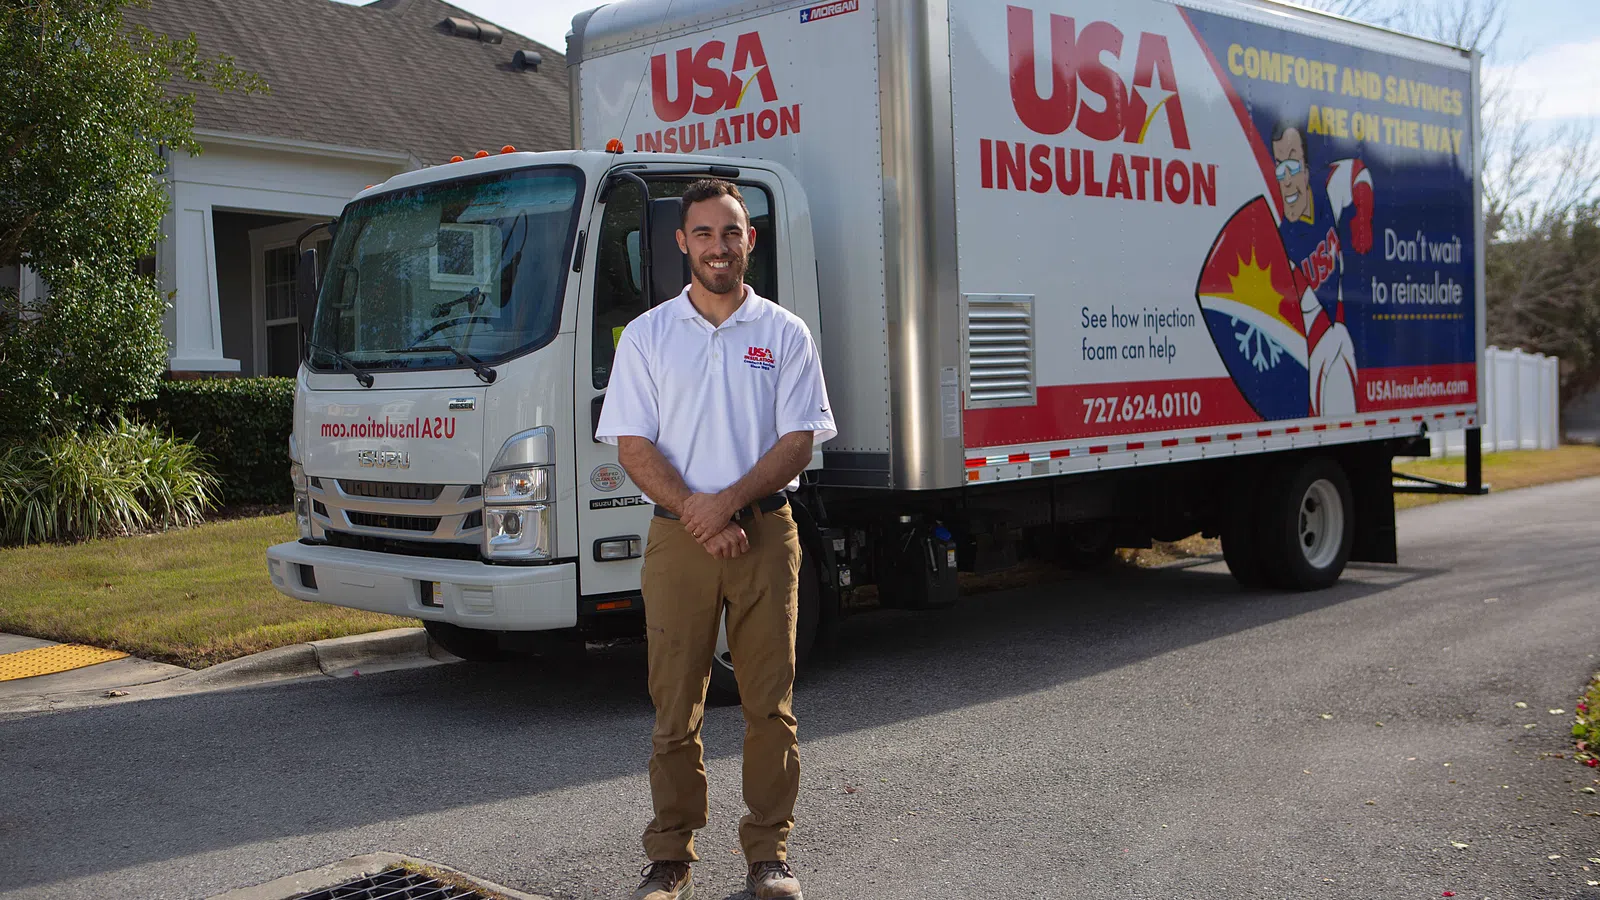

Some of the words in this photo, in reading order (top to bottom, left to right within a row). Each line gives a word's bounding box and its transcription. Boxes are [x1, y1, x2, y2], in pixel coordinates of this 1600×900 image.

[810, 0, 857, 20] MORGAN
[651, 31, 778, 122] USA
[1007, 5, 1191, 150] USA
[1228, 43, 1338, 93] COMFORT
[1341, 67, 1382, 101] AND
[1385, 74, 1464, 117] SAVINGS
[636, 104, 801, 154] INSULATION
[1307, 104, 1349, 139] ARE
[1352, 111, 1380, 144] ON
[1382, 116, 1421, 149] THE
[1421, 124, 1463, 155] WAY
[980, 138, 1217, 207] INSULATION
[1301, 226, 1341, 292] USA
[1384, 228, 1427, 263] Don't
[1428, 234, 1462, 265] wait
[1372, 275, 1388, 305] to
[1392, 270, 1463, 305] reinsulate
[1081, 306, 1107, 328] See
[1112, 305, 1139, 328] how
[1144, 307, 1195, 334] injection
[743, 355, 774, 363] INSULATION
[748, 346, 772, 358] USA
[1082, 337, 1117, 361] foam
[1122, 345, 1144, 359] can
[1149, 335, 1176, 364] help
[1366, 376, 1468, 402] USAInsulation.com
[1083, 391, 1202, 424] 727.624.0110
[358, 450, 411, 469] ISUZU
